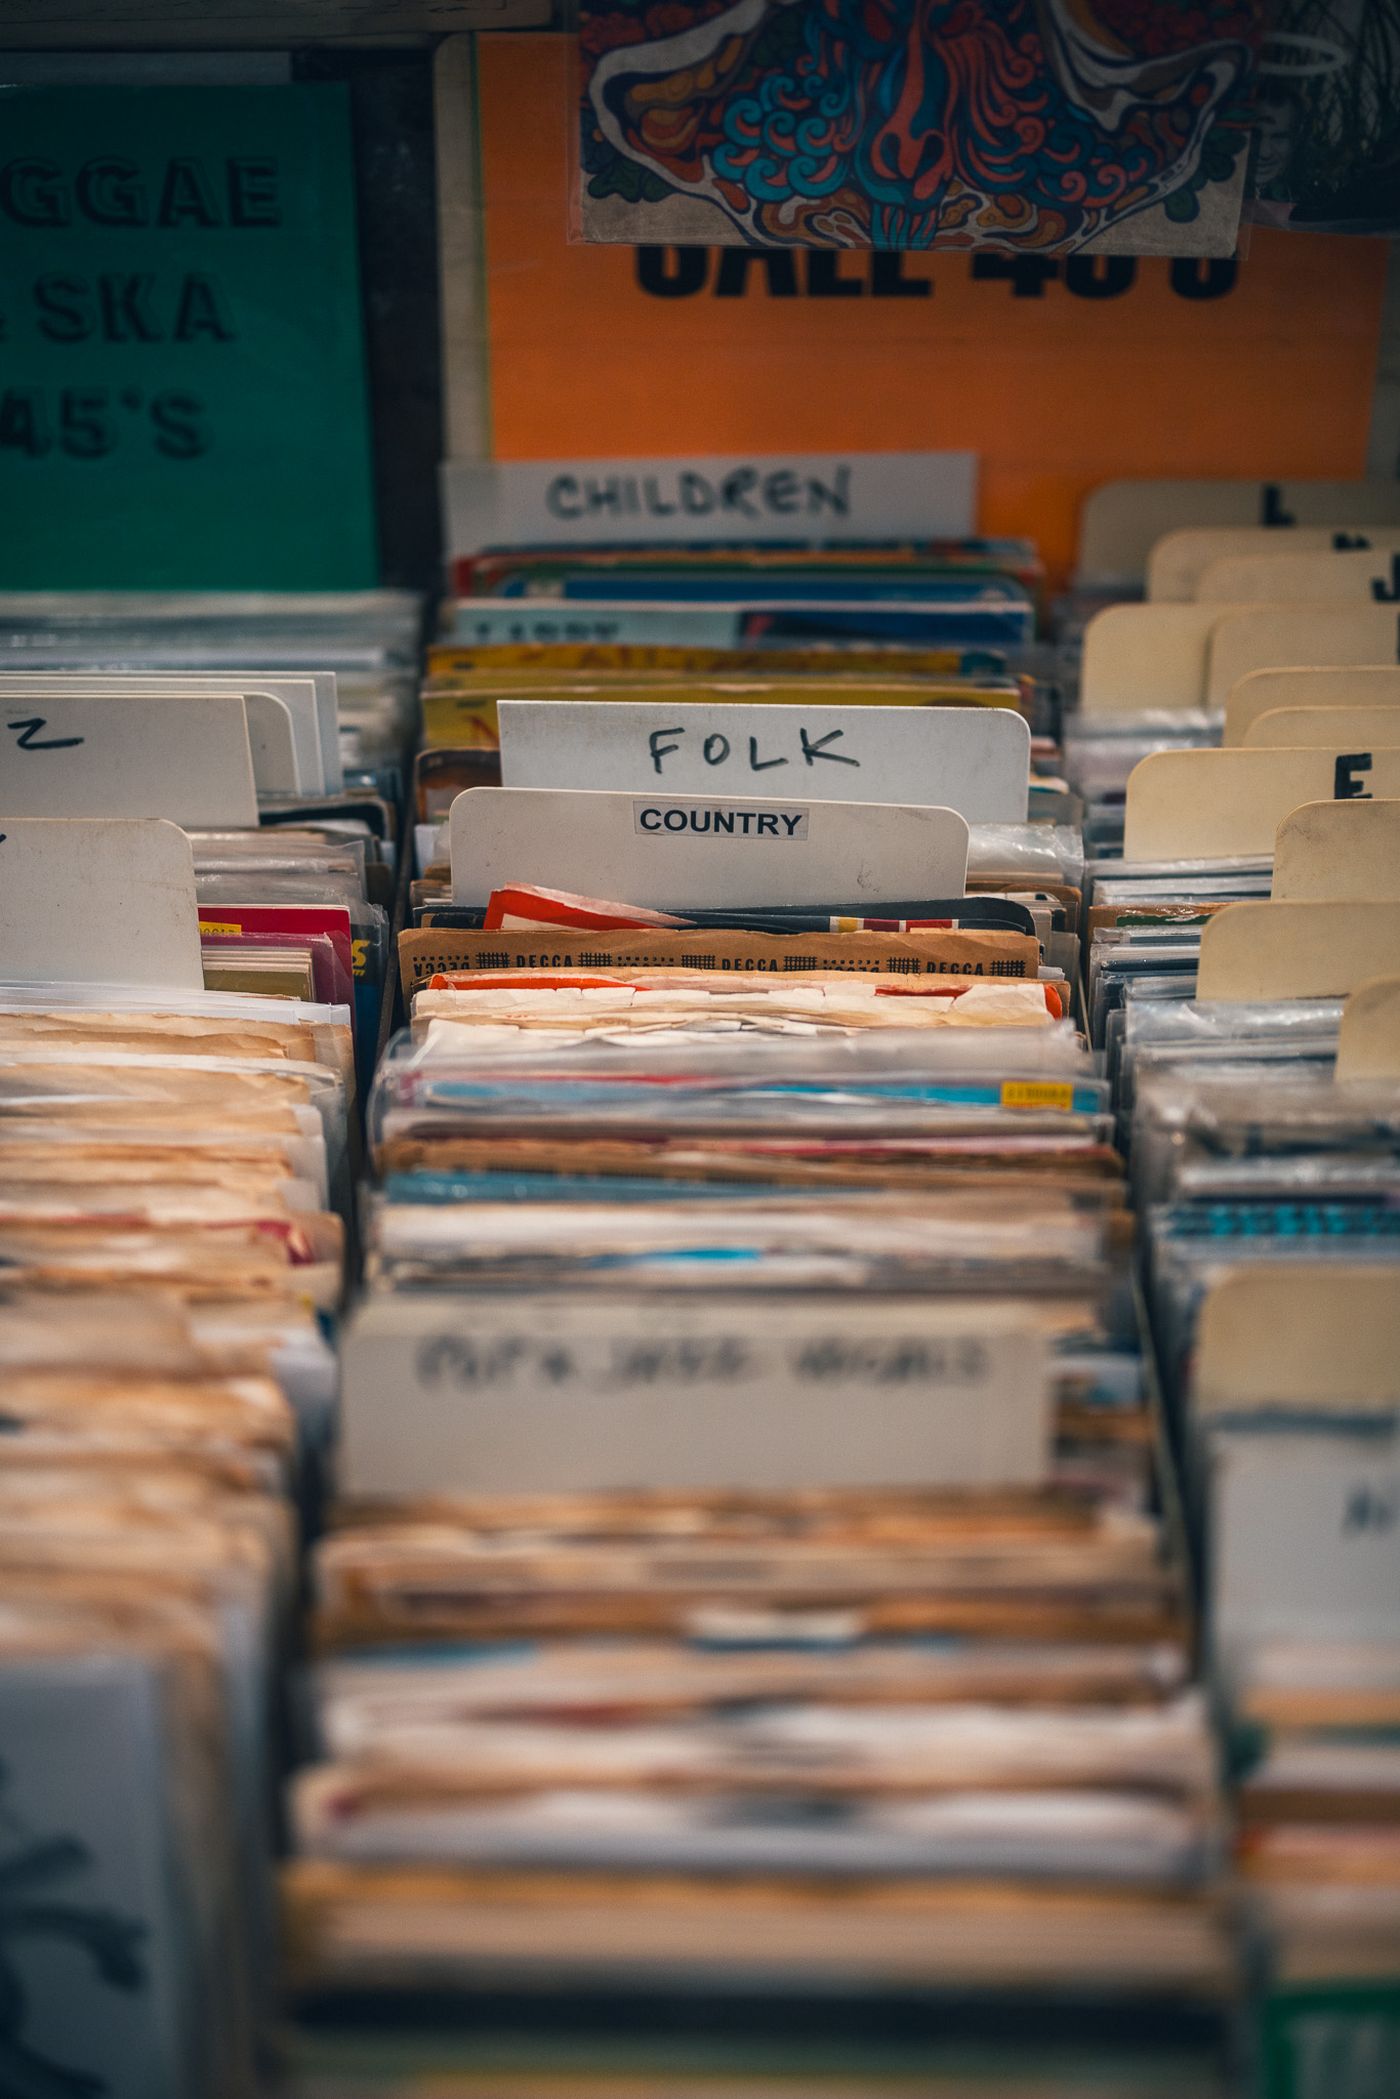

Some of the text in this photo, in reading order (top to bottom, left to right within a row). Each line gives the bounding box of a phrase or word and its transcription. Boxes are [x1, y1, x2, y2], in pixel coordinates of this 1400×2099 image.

[33, 272, 237, 344] SKA
[547, 465, 852, 520] CHILDREN
[649, 727, 860, 774] FOLK
[1334, 752, 1373, 800] E
[639, 808, 802, 836] COUNTRY
[516, 954, 573, 968] DECCA
[721, 958, 778, 972] DECCA
[927, 961, 984, 976] DECCA
